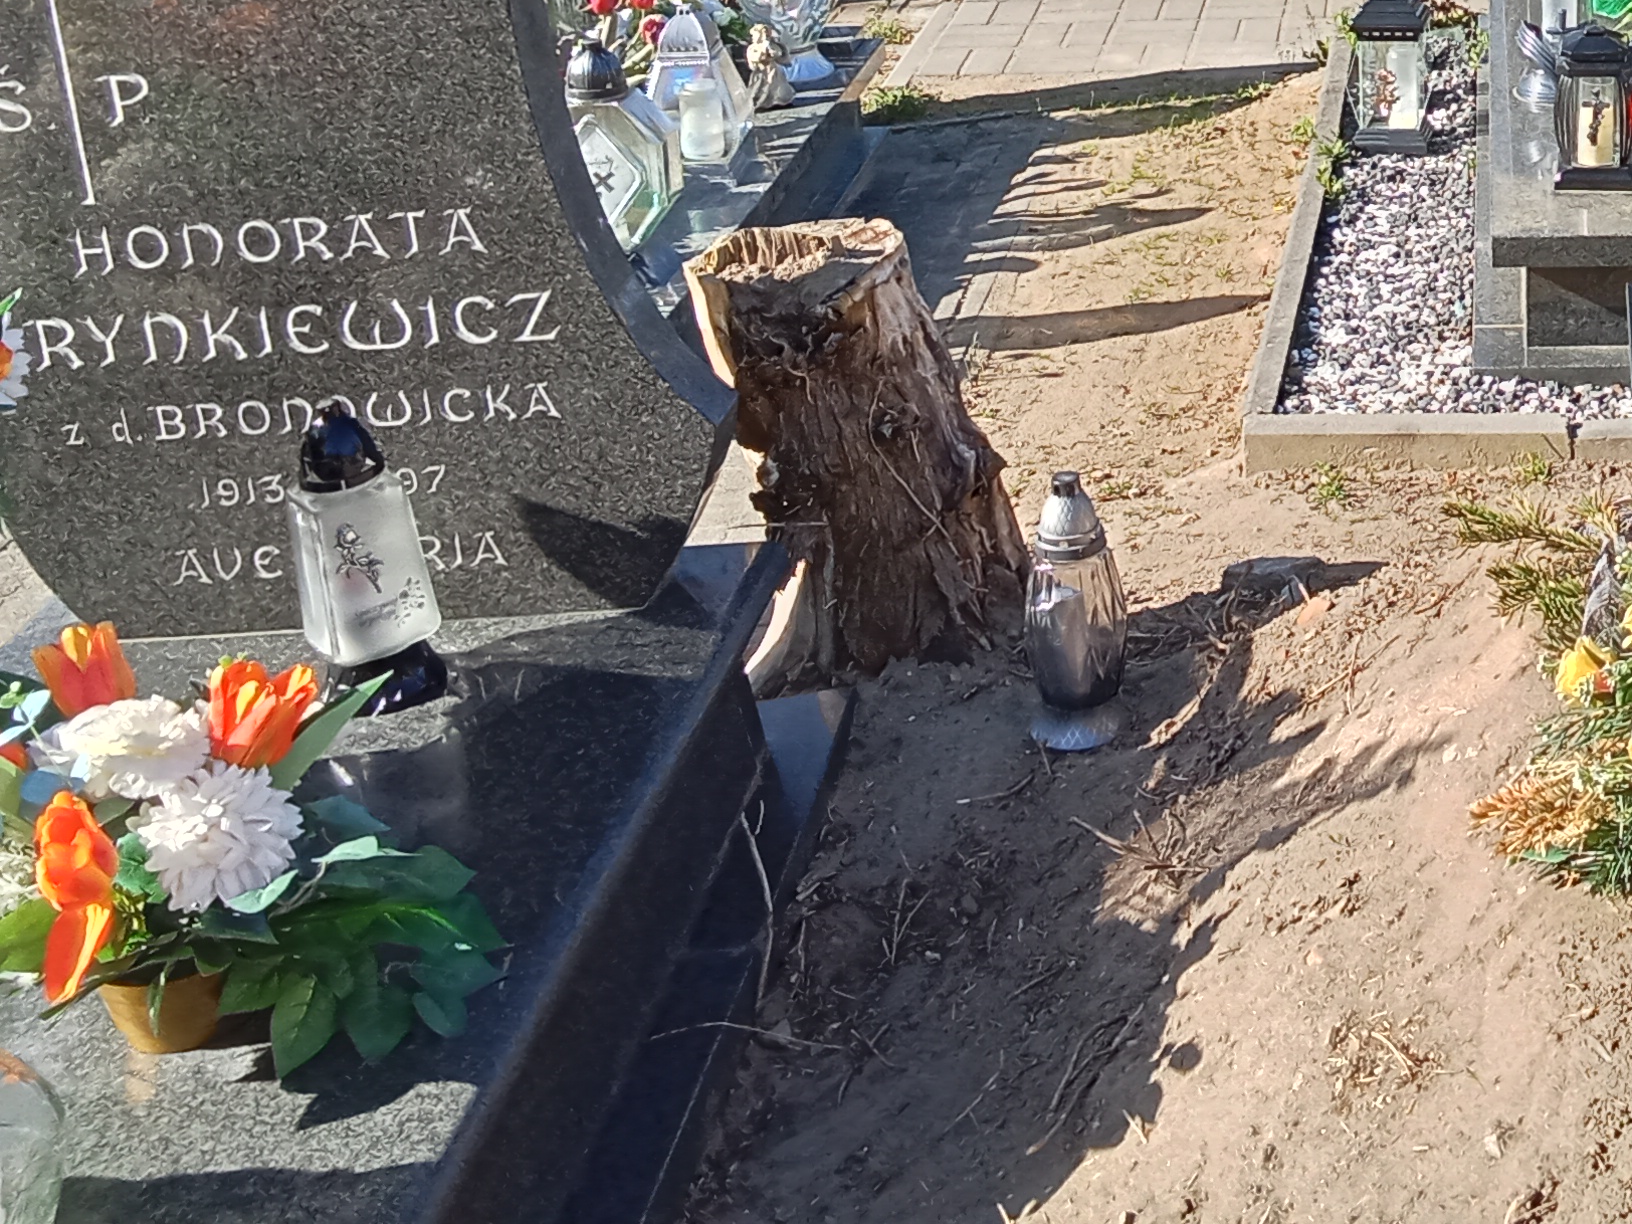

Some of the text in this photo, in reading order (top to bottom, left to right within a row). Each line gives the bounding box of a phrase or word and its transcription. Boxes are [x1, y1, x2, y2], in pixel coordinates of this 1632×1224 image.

[73, 206, 489, 278] HONORATA
[22, 289, 562, 373] RYNKIEWICZ
[418, 529, 509, 570] RIA
